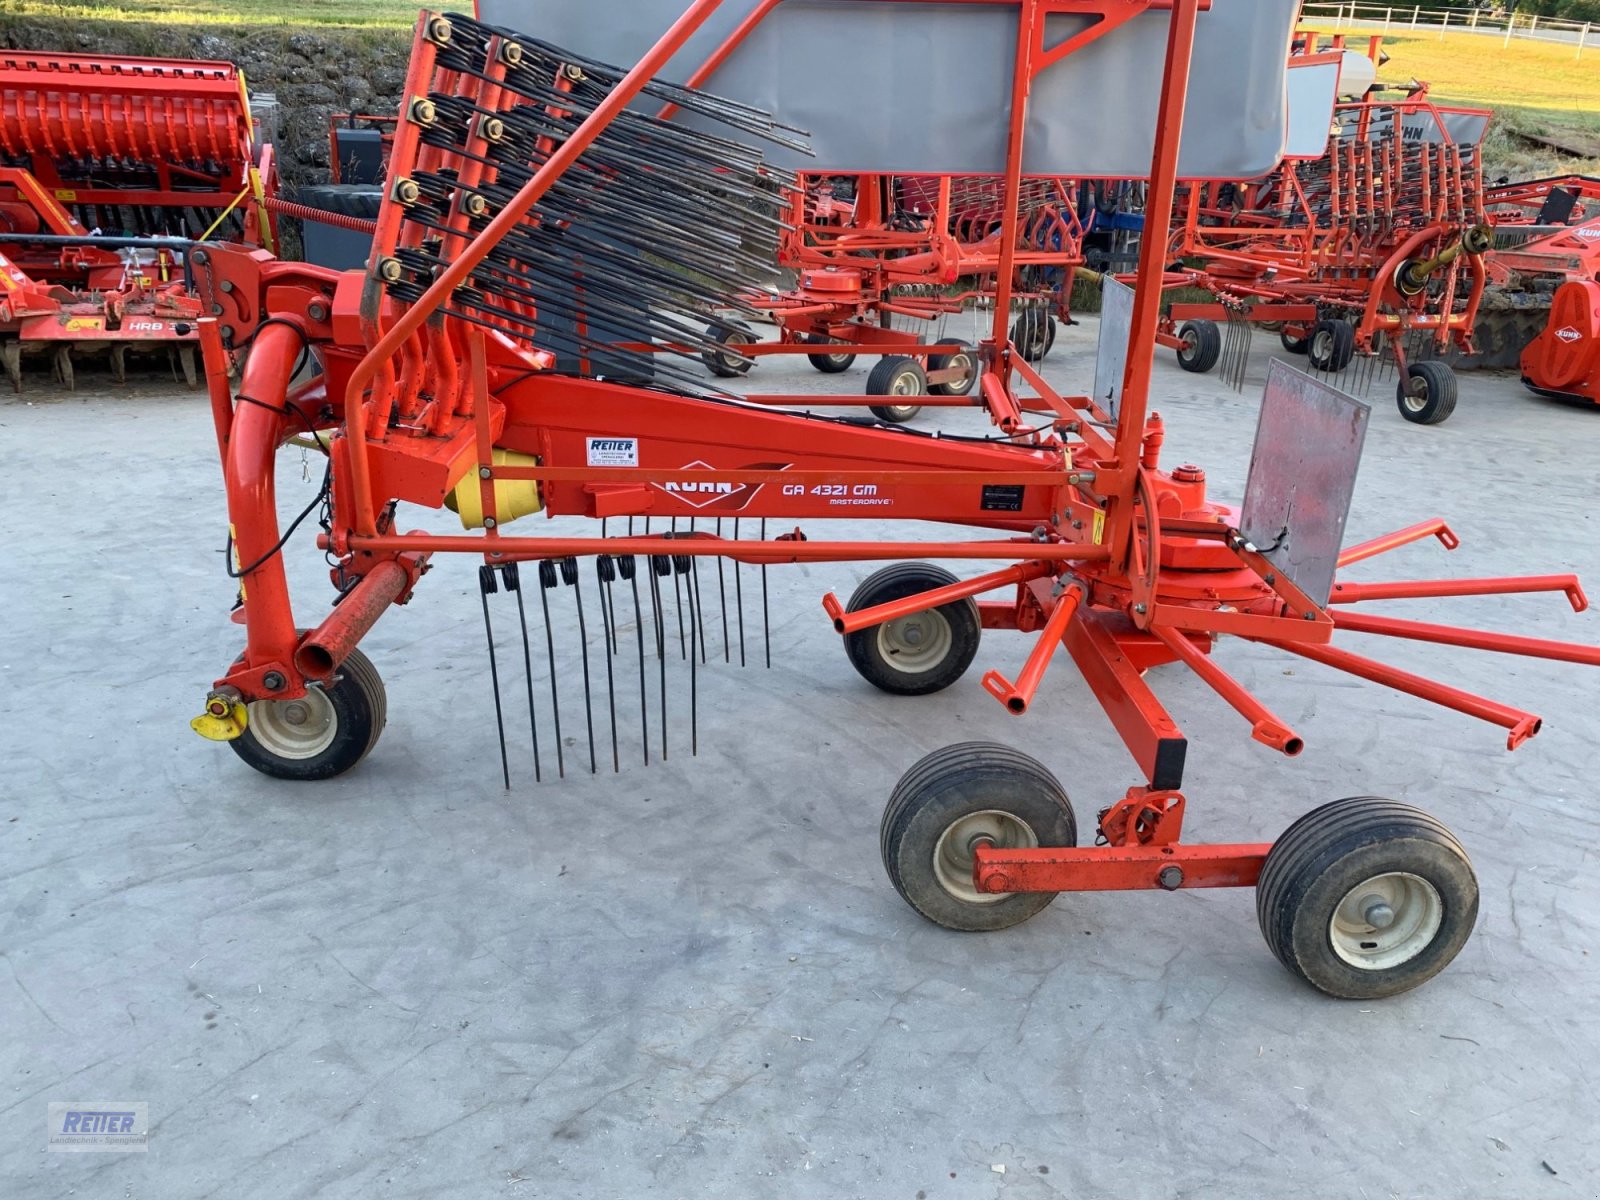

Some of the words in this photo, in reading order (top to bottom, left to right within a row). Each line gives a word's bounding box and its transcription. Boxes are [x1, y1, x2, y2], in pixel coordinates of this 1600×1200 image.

[1579, 228, 1600, 237] KUH
[129, 322, 163, 331] HRB
[1558, 330, 1579, 339] KUHN
[591, 440, 634, 451] REITER
[782, 484, 805, 495] GA
[810, 484, 848, 495] 4321
[852, 484, 877, 495] GM
